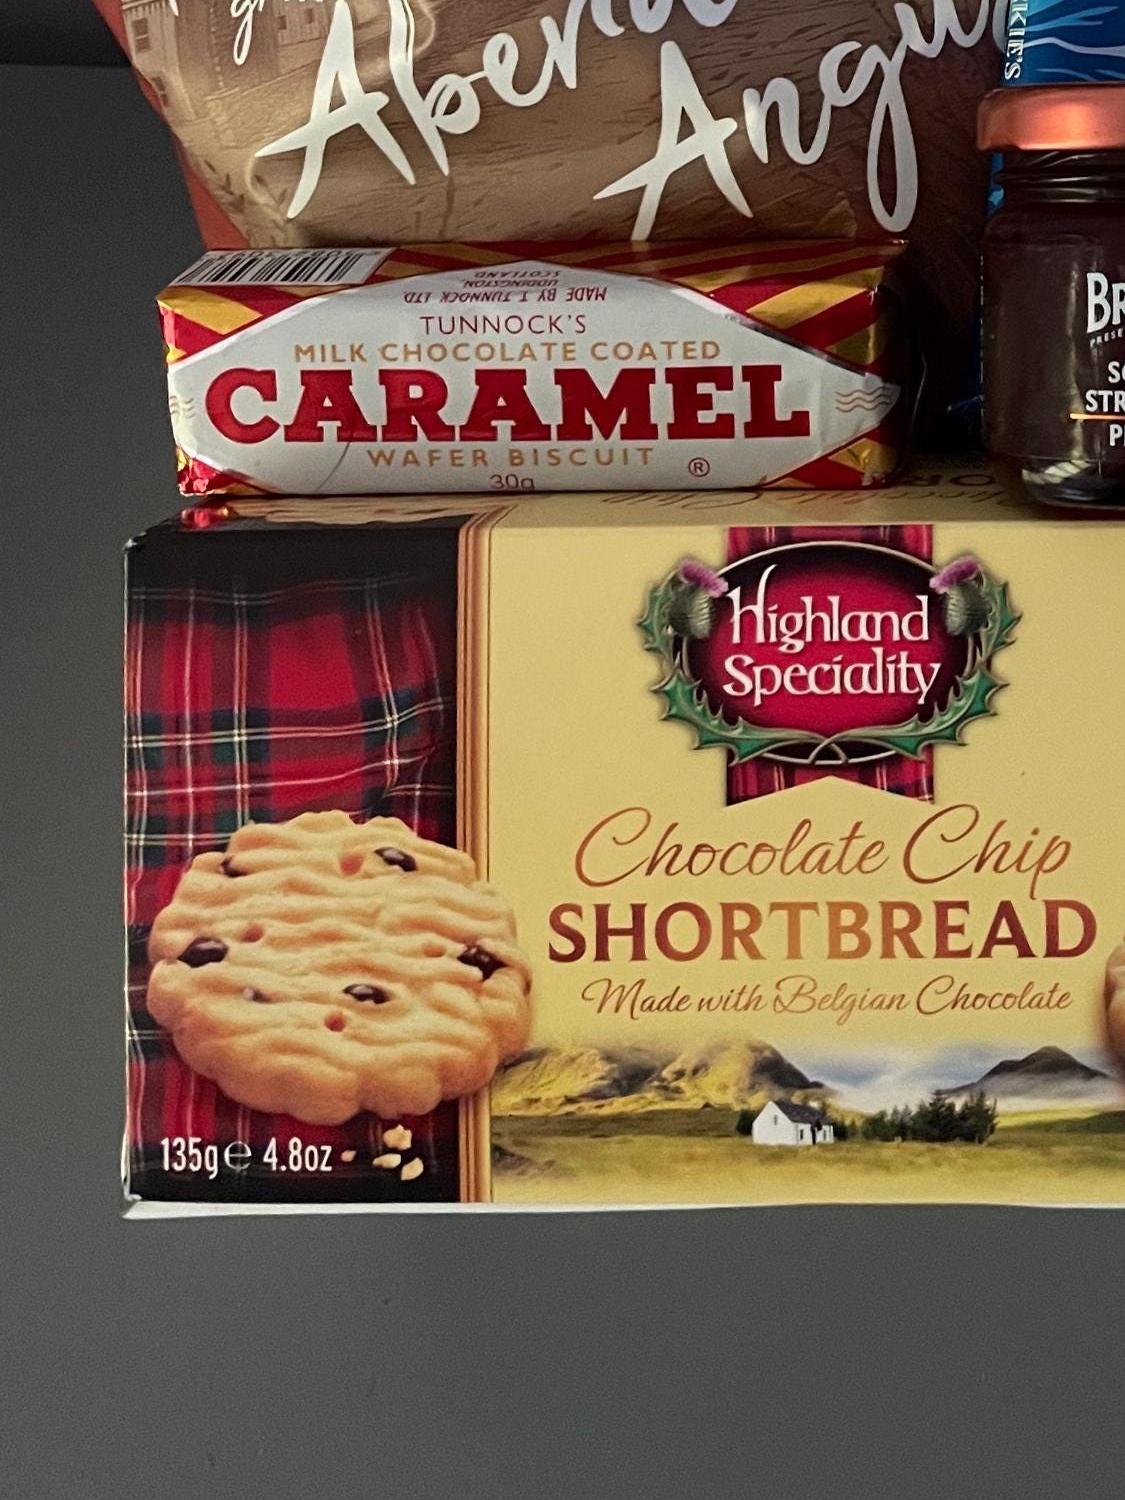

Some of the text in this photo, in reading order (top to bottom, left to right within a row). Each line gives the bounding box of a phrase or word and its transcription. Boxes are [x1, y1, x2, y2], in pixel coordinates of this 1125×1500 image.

[440, 291, 512, 303] TUNNOCK
[538, 289, 557, 302] BY
[565, 287, 607, 302] MADE
[420, 312, 588, 337] TUNNOCK'S
[294, 340, 722, 363] MILK CHOCOLATE COATED
[204, 364, 812, 443] CARAMEL
[366, 445, 654, 470] WAFER BISCUIT
[490, 472, 536, 491] 30g
[728, 563, 931, 653] Highland
[723, 646, 942, 706] Speciality
[574, 804, 1073, 900] Chocolate Chip
[547, 899, 1098, 964] SHORTBREAD
[581, 975, 1073, 1025] Made with Belgian Chocolate
[160, 1136, 219, 1180] 135g
[262, 1136, 333, 1172] 4.8oz
